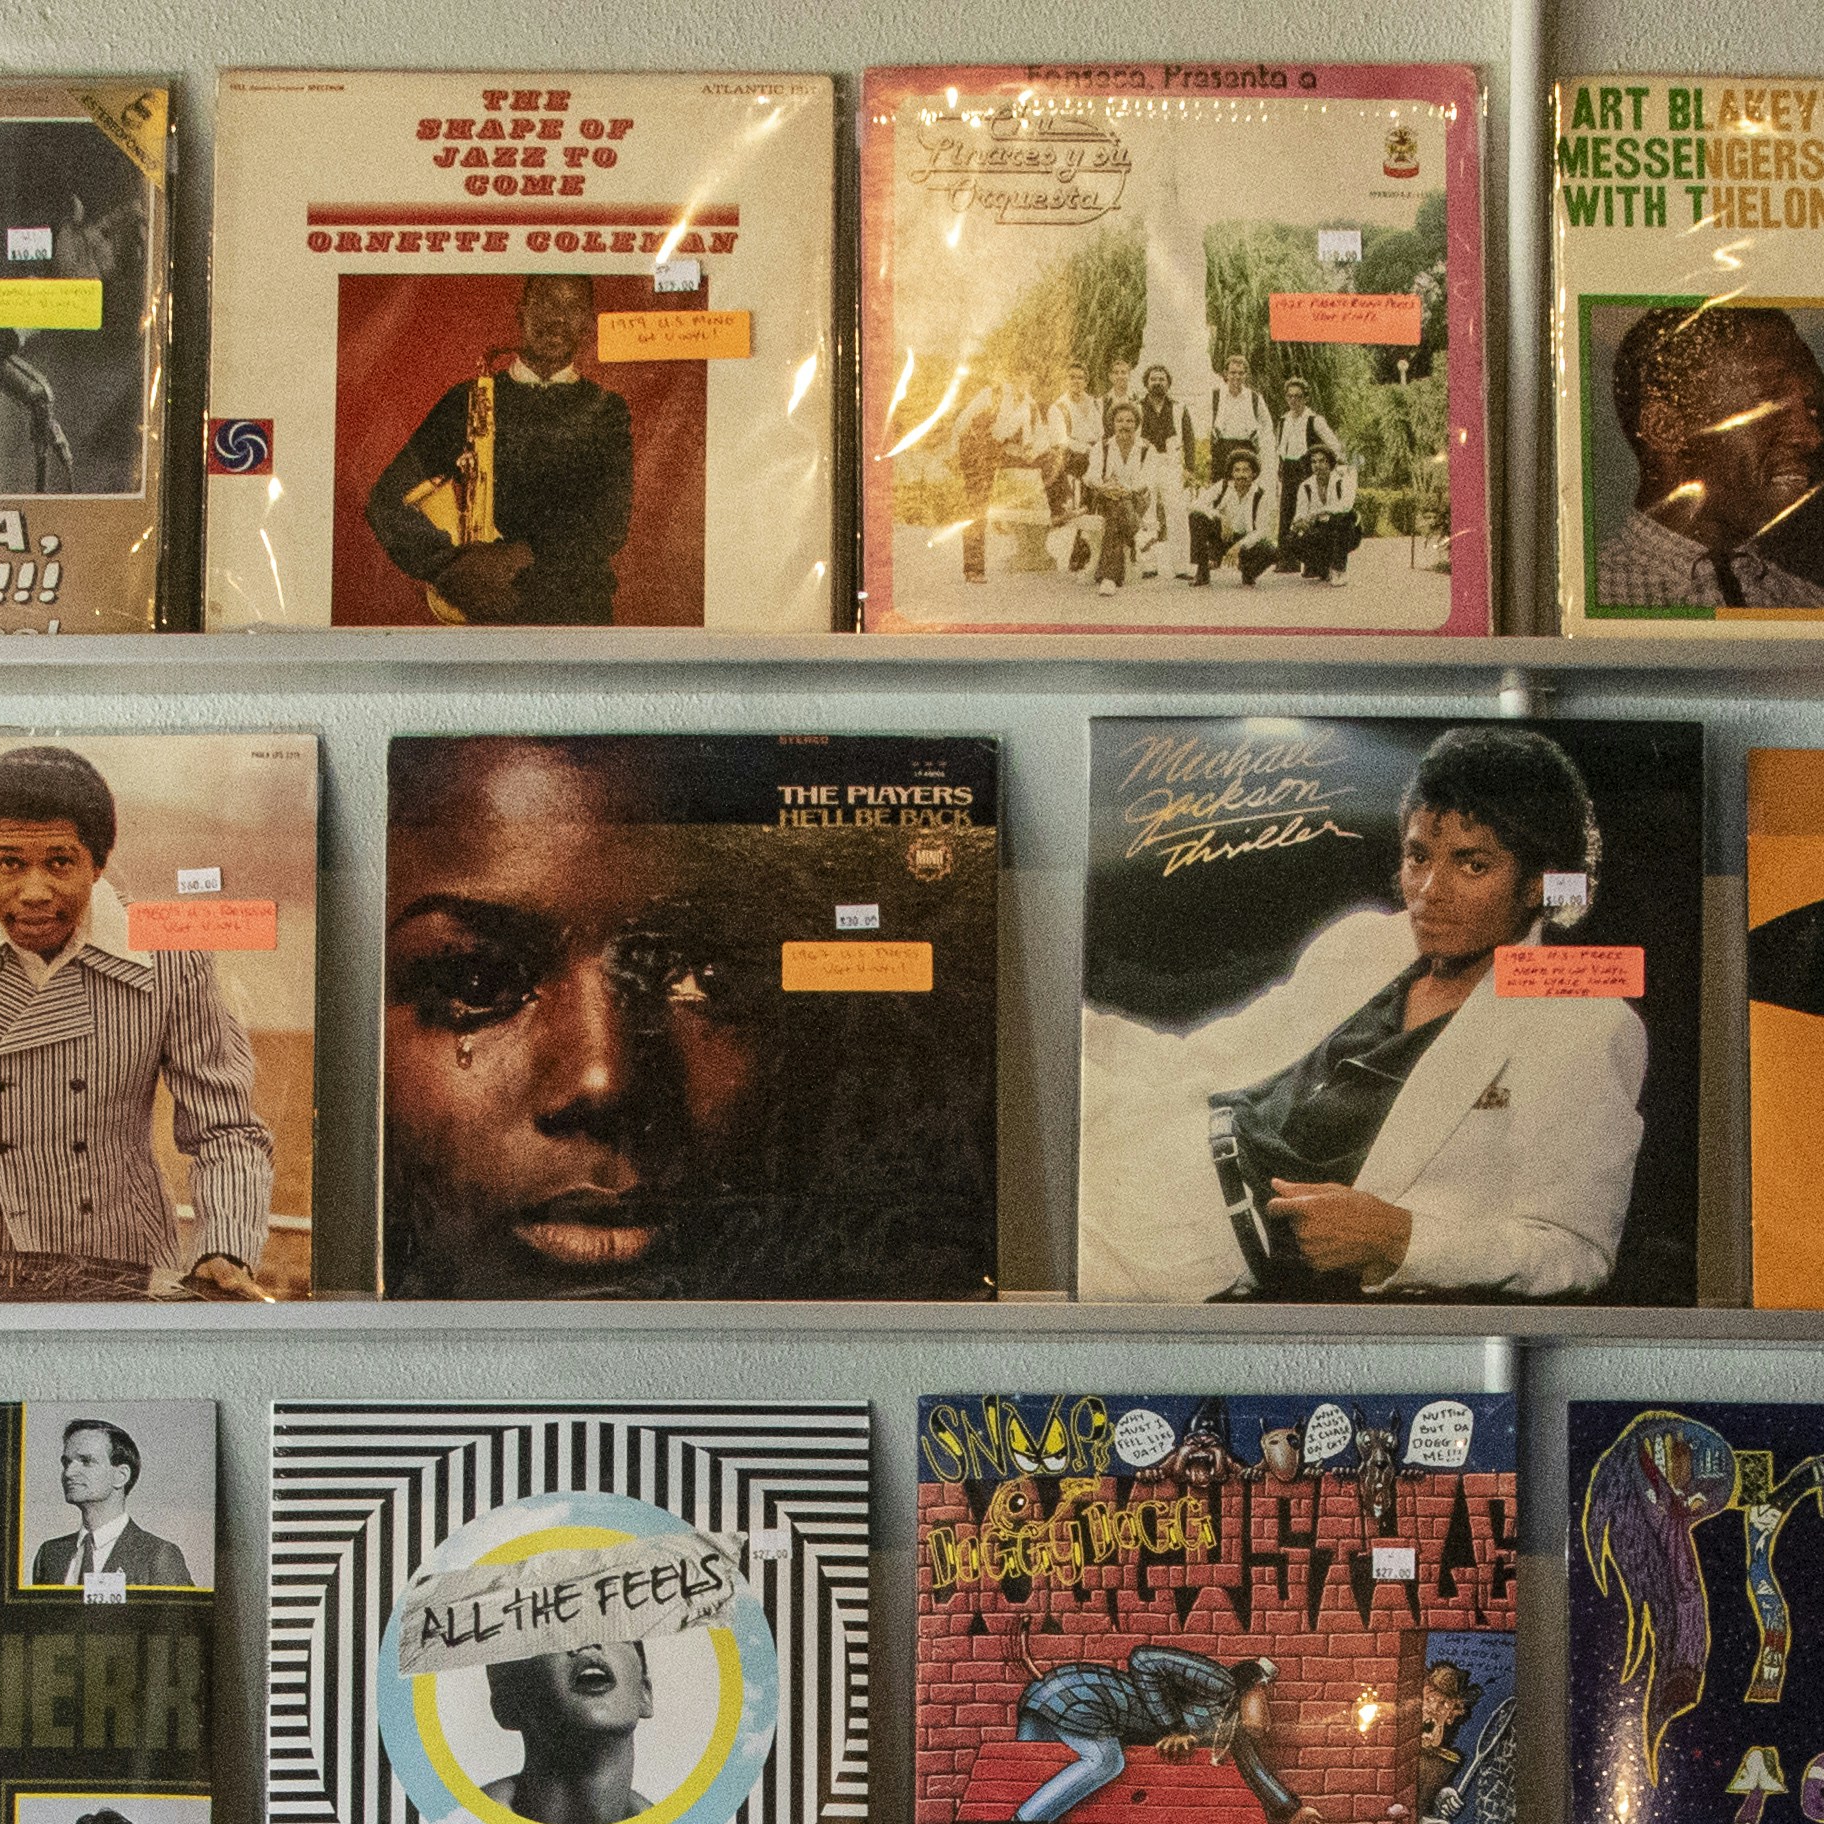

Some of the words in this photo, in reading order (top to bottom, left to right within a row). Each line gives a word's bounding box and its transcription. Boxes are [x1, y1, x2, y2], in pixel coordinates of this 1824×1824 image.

[482, 90, 571, 112] THE
[1573, 87, 1650, 131] ART
[417, 118, 567, 141] SHAPE
[578, 118, 634, 141] OF
[433, 147, 549, 168] JAZZ
[563, 147, 619, 168] TO
[463, 174, 586, 197] COME
[1562, 186, 1667, 228] WITH
[307, 231, 510, 253] ORNETTE
[778, 785, 839, 806] THE
[847, 784, 974, 806] PLAYERS
[855, 808, 891, 829] BE
[900, 808, 974, 830] BACK
[1157, 816, 1364, 876] Thriller
[420, 1605, 503, 1648] ALL
[503, 1585, 582, 1632] THE
[594, 1553, 724, 1616] FEELS
